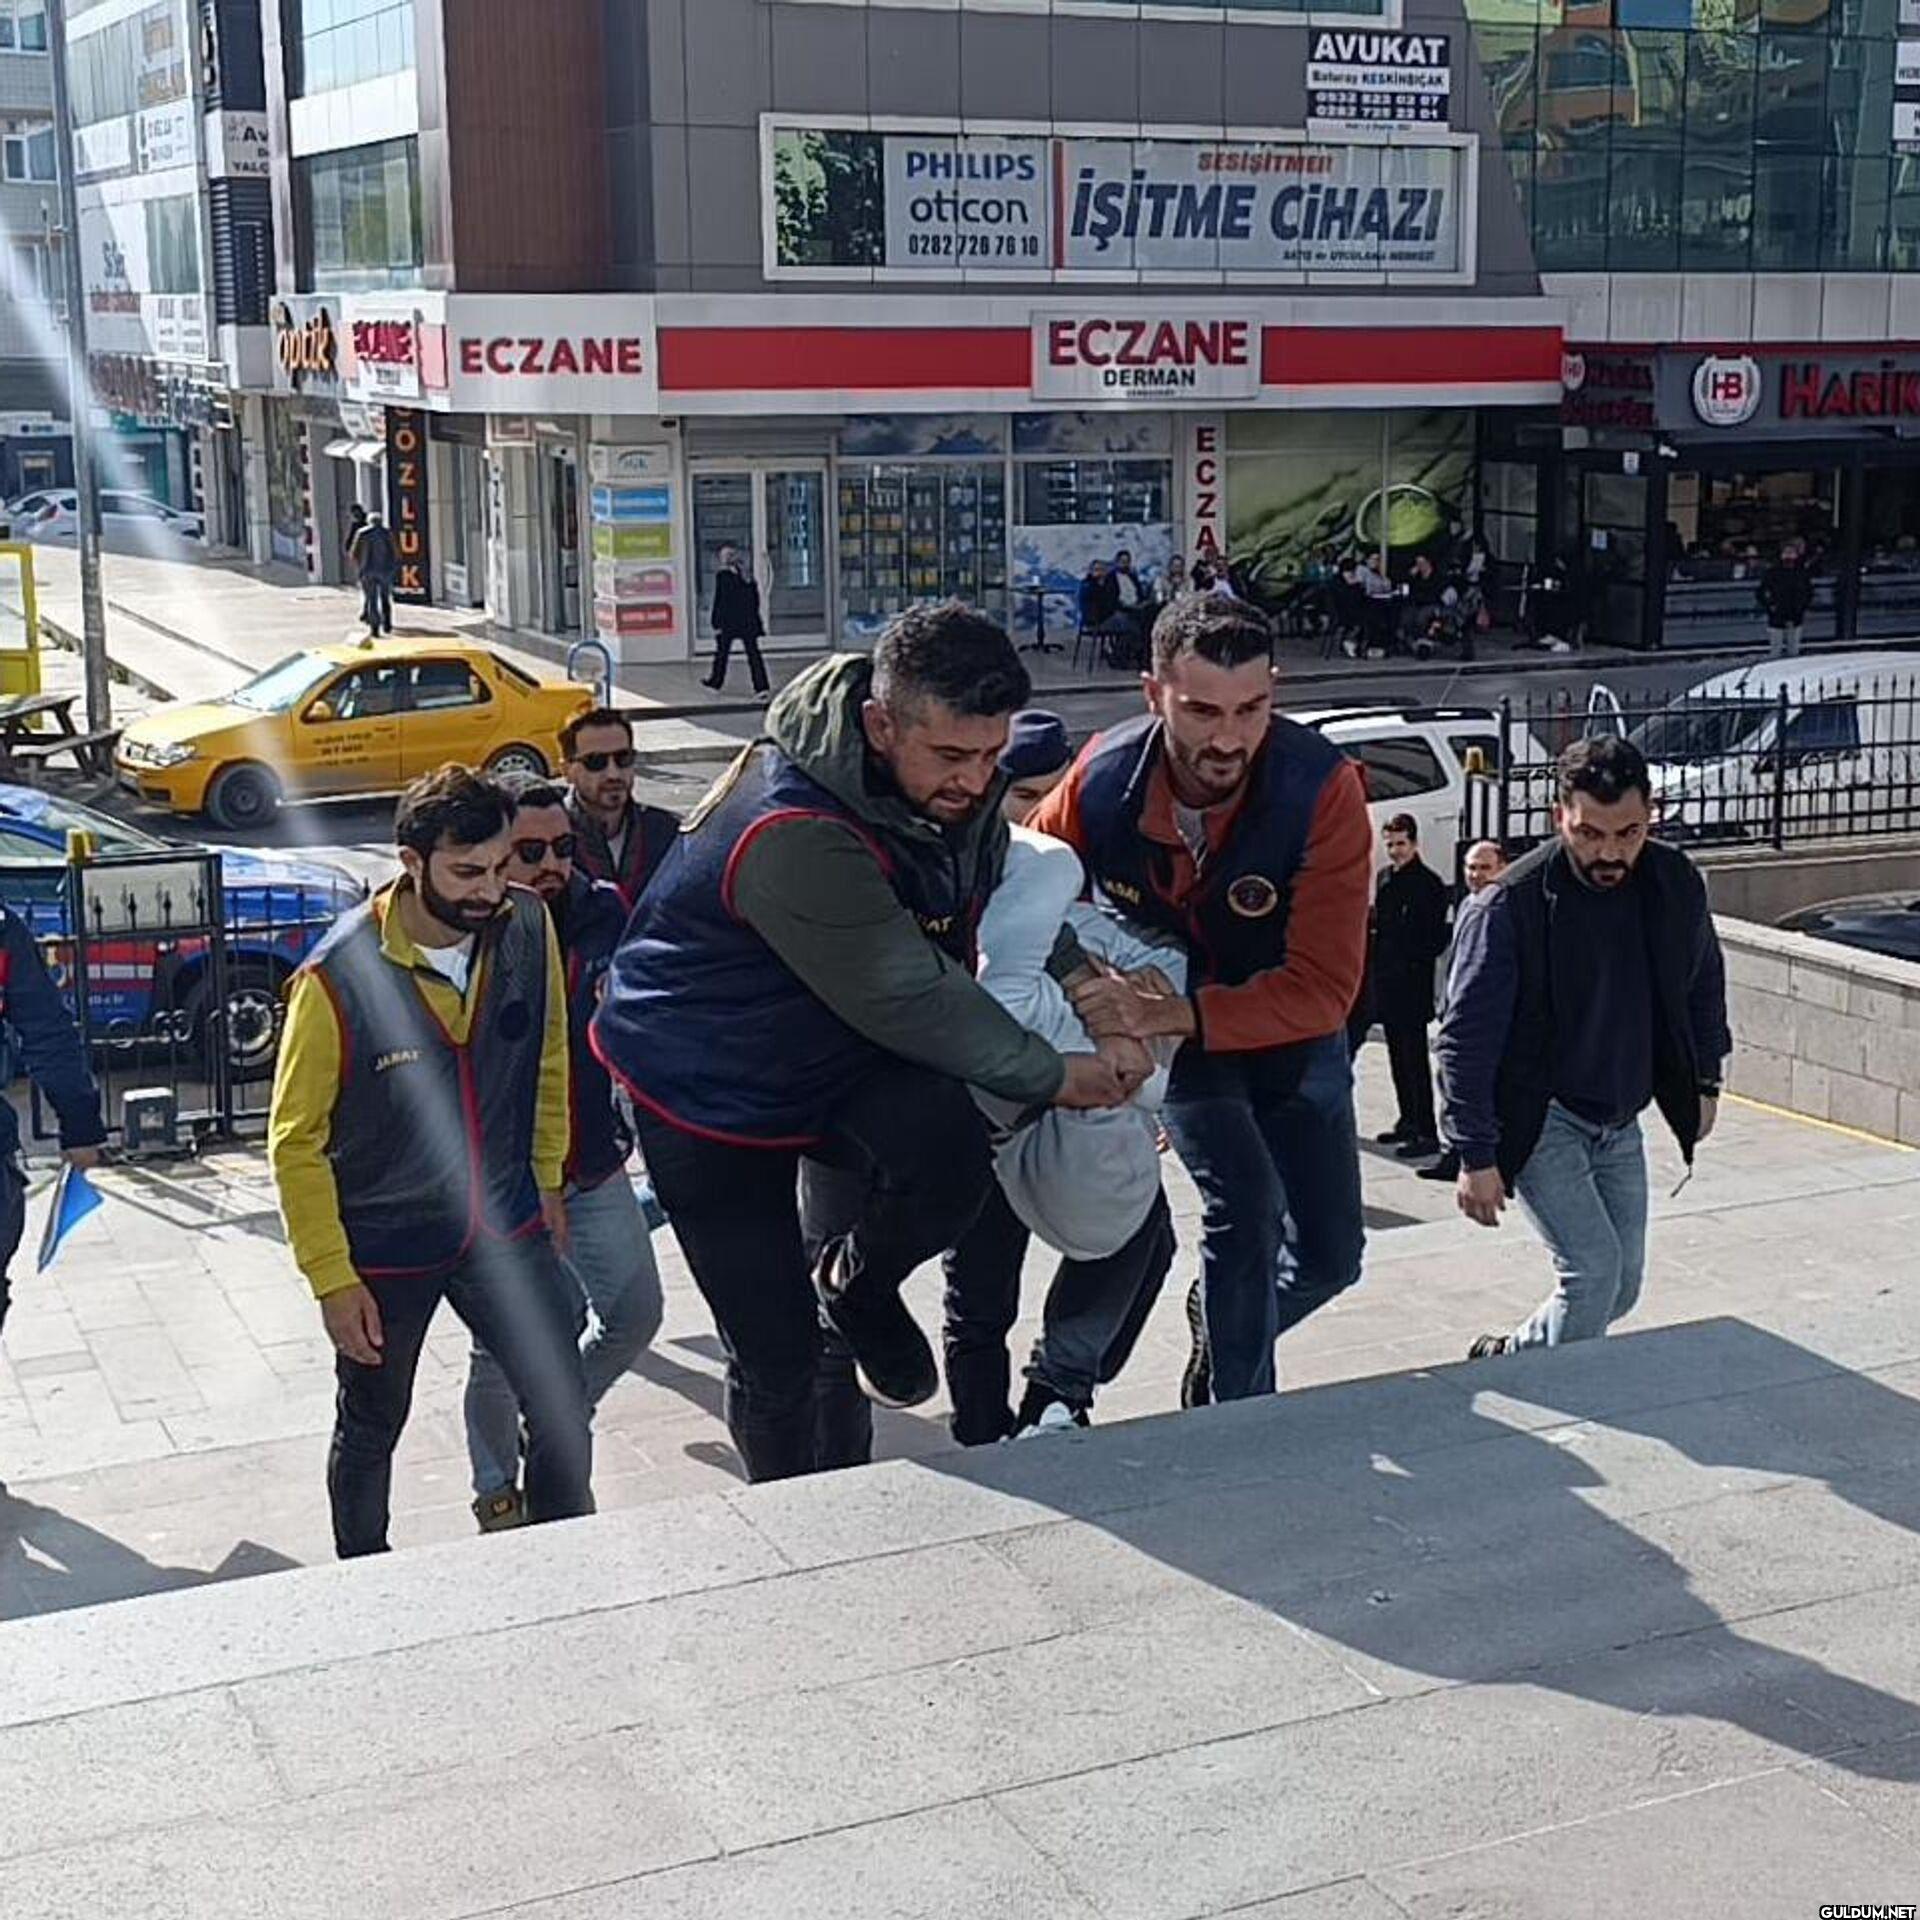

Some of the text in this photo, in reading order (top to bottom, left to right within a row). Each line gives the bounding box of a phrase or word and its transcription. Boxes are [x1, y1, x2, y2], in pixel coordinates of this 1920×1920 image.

[1314, 33, 1446, 64] AVUKAT
[906, 151, 1036, 181] PHILIPS
[910, 190, 1029, 225] oticon
[1071, 168, 1257, 251] İŞİTME
[909, 234, 951, 256] 0282
[460, 337, 642, 374] ECZANE
[1049, 319, 1248, 366] ECZANE
[1103, 368, 1196, 387] DERMAN
[394, 409, 421, 588] ÖZLÜK
